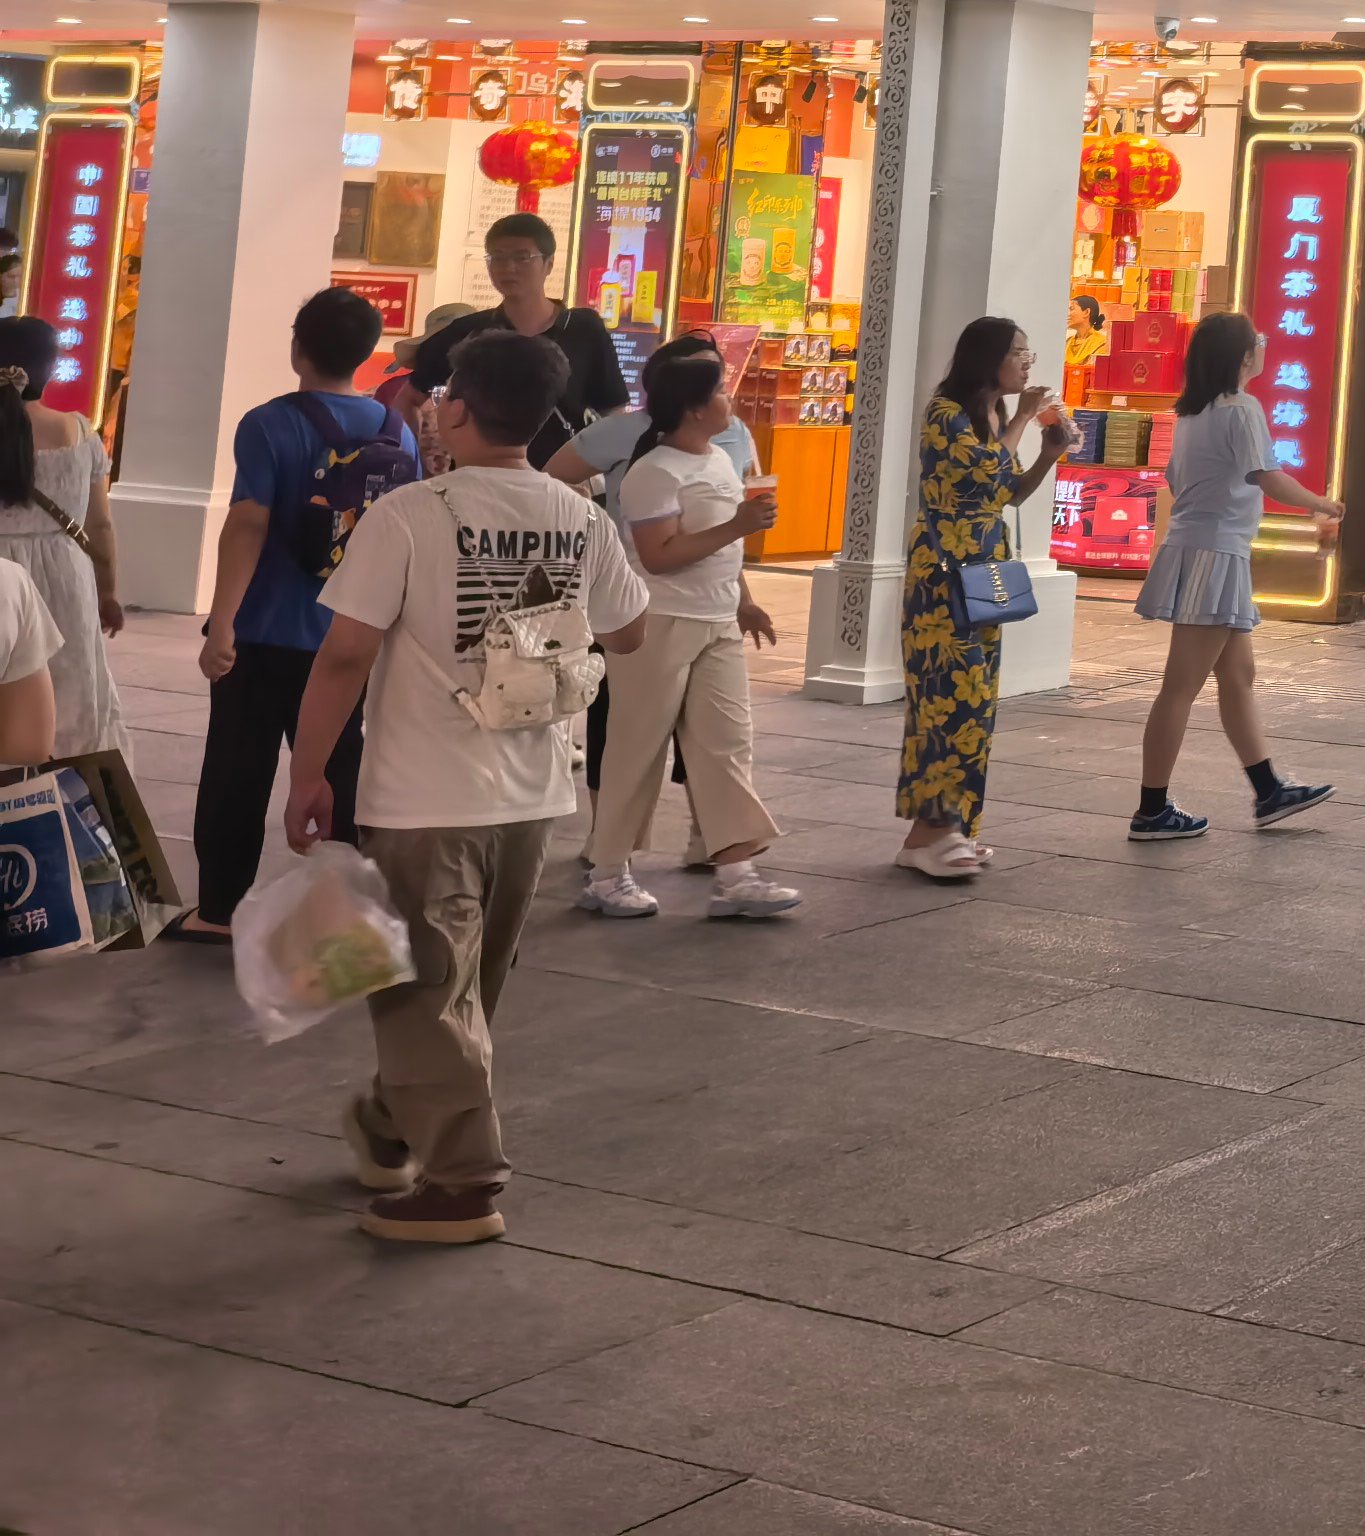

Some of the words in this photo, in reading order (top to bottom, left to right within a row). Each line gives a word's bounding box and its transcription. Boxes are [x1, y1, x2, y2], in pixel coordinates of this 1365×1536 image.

[755, 83, 784, 114] 中
[1160, 89, 1199, 123] 字
[64, 164, 102, 279] 中国茶礼
[1278, 195, 1322, 337] 厦门茶礼
[1271, 361, 1311, 468] 送海堤
[456, 525, 586, 561] CAMPING
